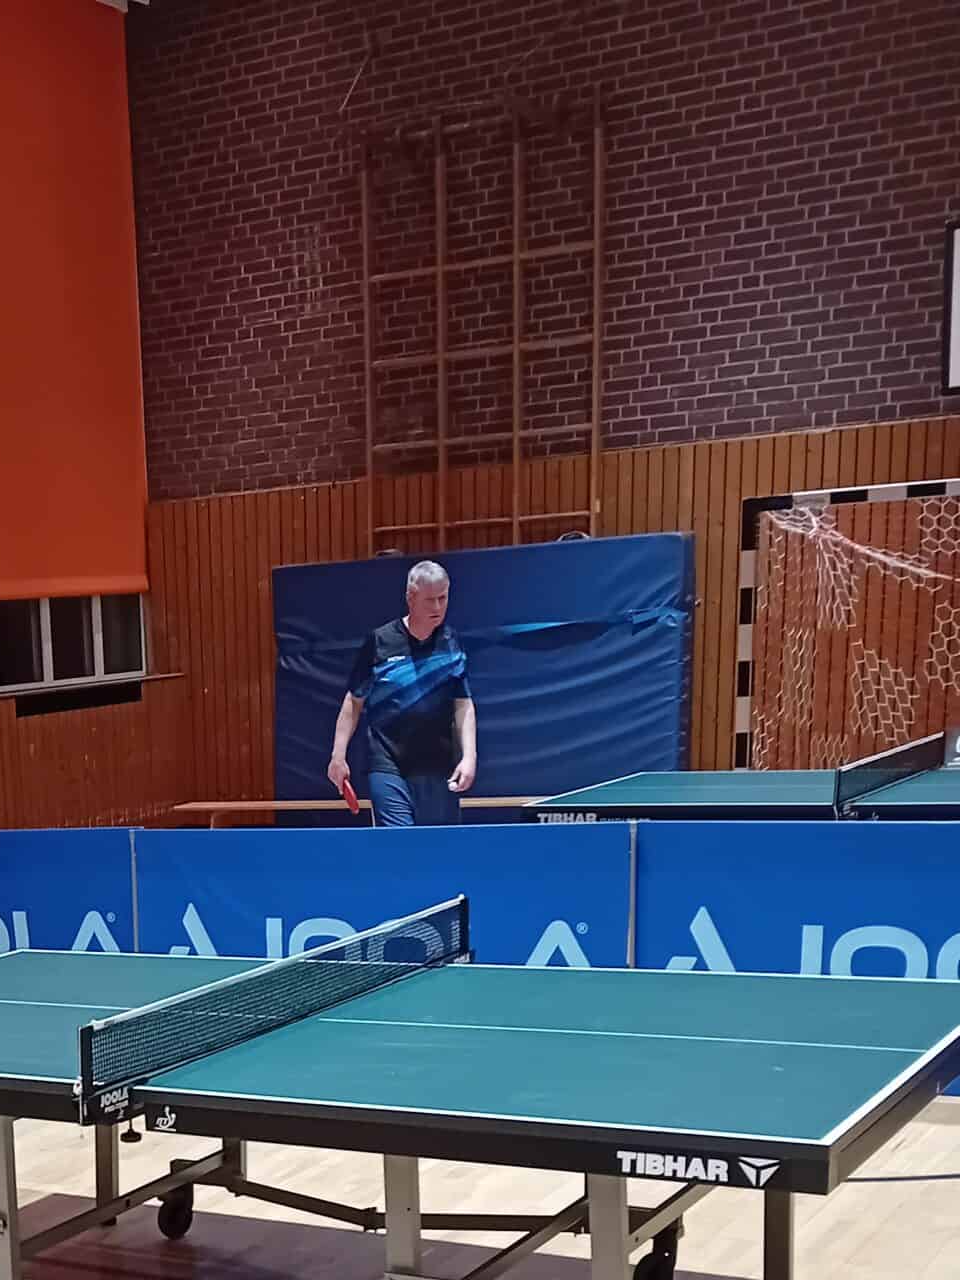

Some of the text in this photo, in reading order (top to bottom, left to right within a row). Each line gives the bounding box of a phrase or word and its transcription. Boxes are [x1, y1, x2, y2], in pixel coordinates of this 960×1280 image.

[537, 812, 598, 825] TIBHAR
[100, 1085, 129, 1109] JOOLA
[616, 1150, 729, 1183] TIBHAR
